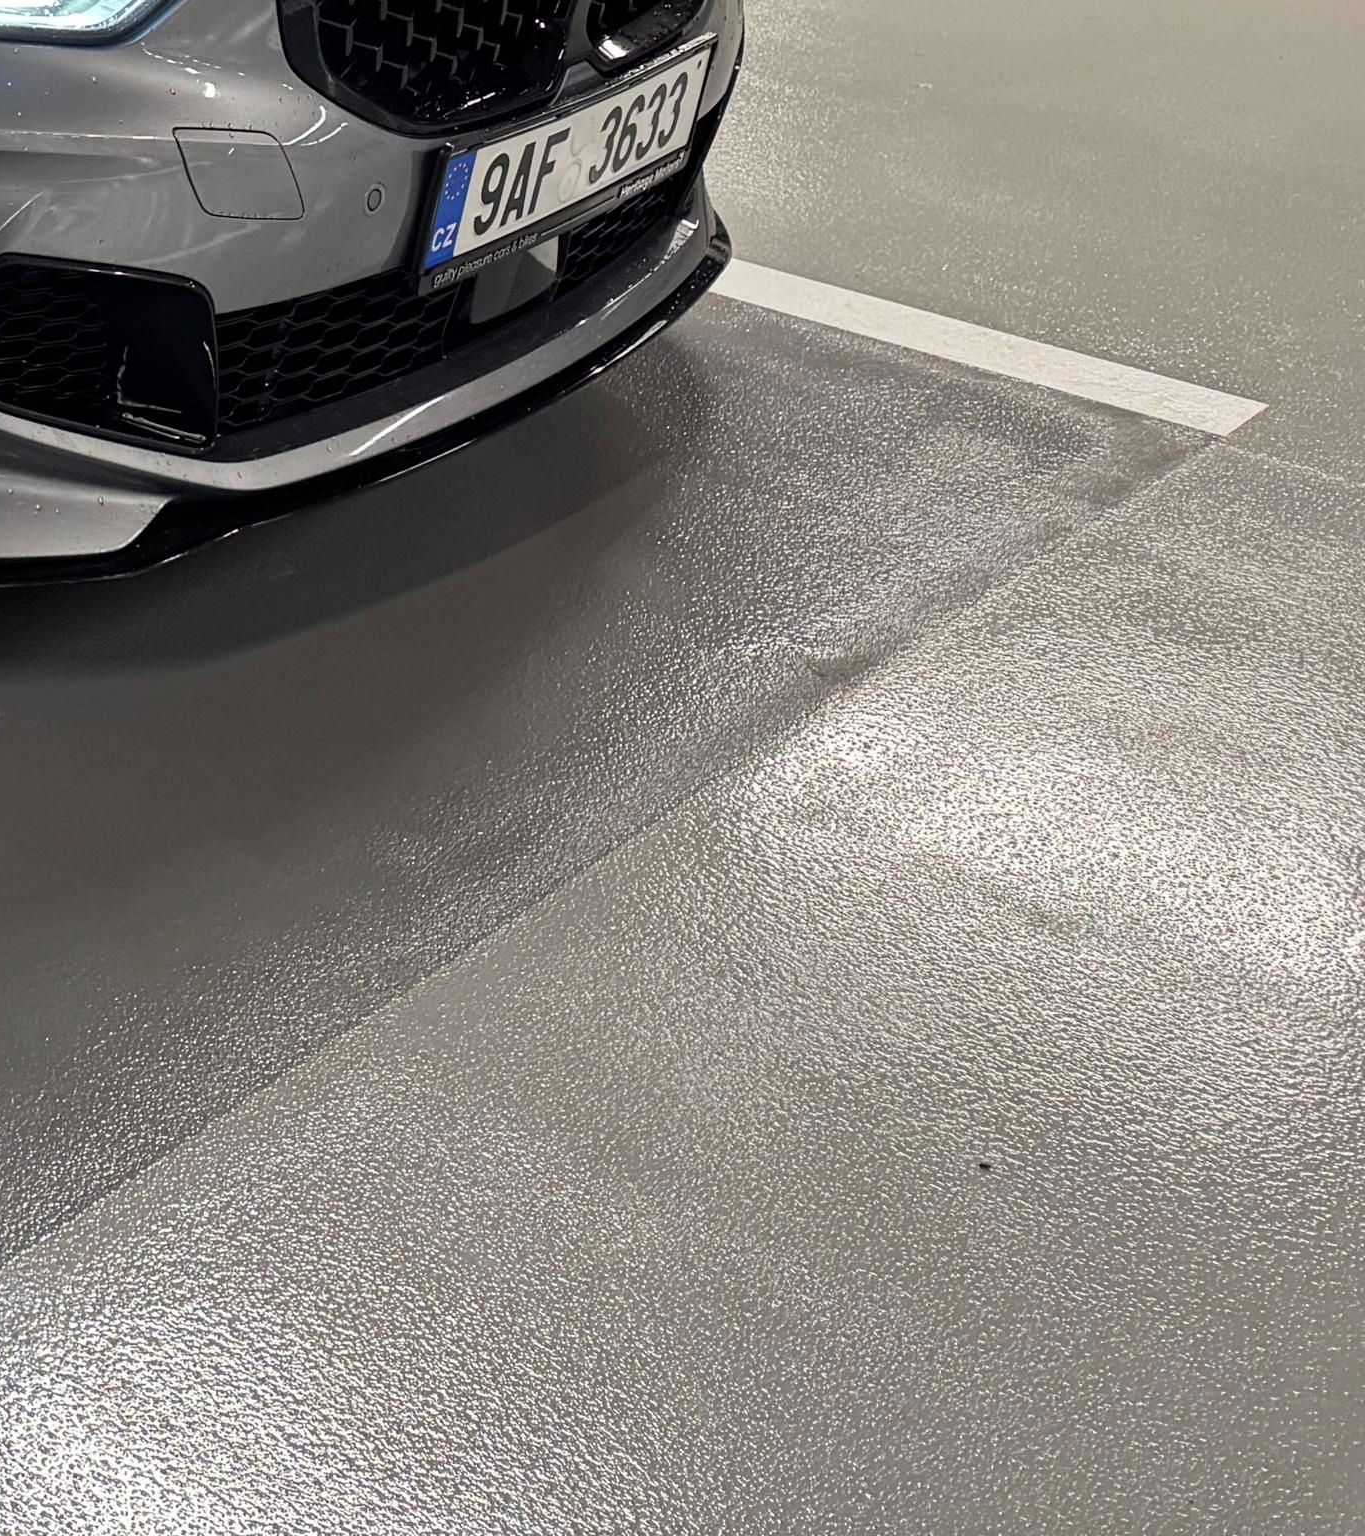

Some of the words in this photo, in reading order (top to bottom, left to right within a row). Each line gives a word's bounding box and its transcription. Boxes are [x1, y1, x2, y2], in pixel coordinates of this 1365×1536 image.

[473, 127, 571, 236] 9AF
[588, 71, 689, 185] 3633
[431, 223, 457, 252] CZ
